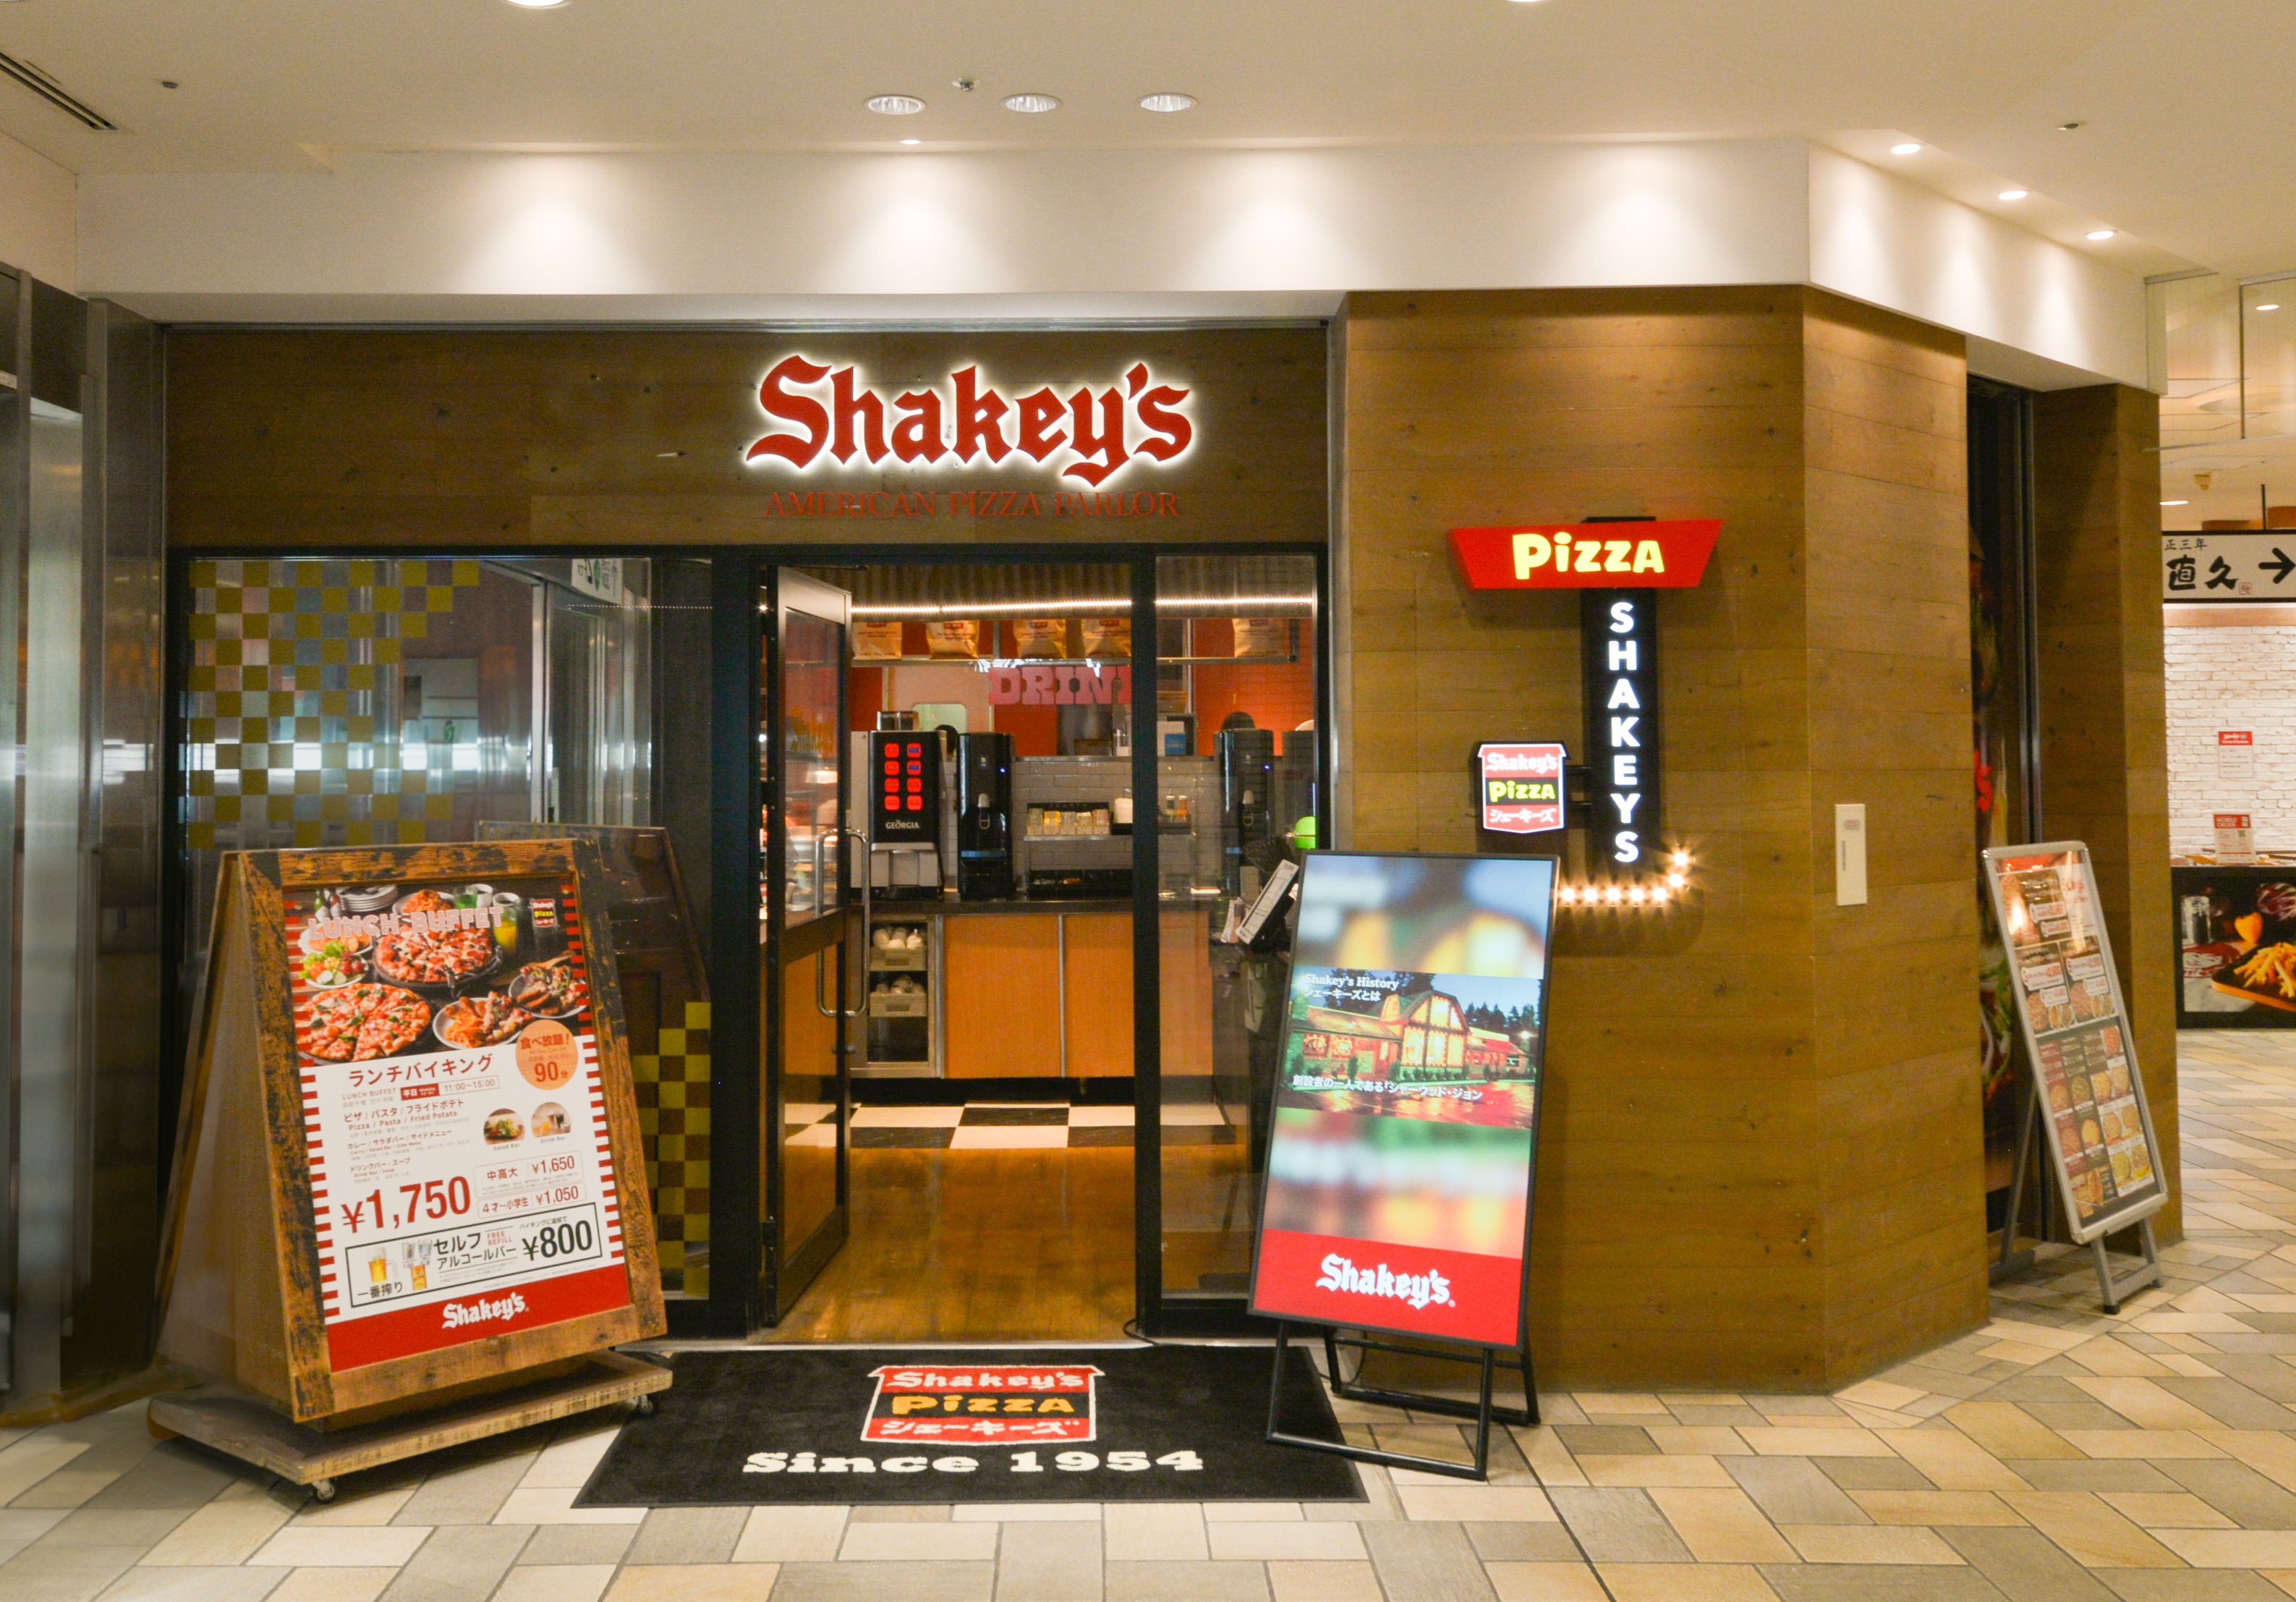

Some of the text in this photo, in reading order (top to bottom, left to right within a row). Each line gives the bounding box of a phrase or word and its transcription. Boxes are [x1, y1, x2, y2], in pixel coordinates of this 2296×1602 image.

[746, 355, 1193, 487] Shakey's
[764, 491, 1180, 518] AMERICAN PIZZA PARLOR
[2166, 554, 2240, 591] 直久
[1607, 602, 1641, 863] SHAKEYS
[1485, 753, 1558, 774] Shakey's
[1489, 808, 1557, 823] シェーキーズ
[307, 906, 504, 941] LUNCH BUFFET
[1304, 973, 1400, 991] Shakey's History
[1304, 988, 1382, 1001] シェーキーズとは
[349, 1053, 493, 1088] ランチバイキング
[342, 1088, 396, 1101] LUNCH BUFFET
[371, 1107, 398, 1119] パスタ
[406, 1098, 464, 1114] フライドポテト
[433, 1111, 458, 1119] Potato
[487, 1155, 576, 1181] 中高大 ¥1,650
[341, 1176, 471, 1234] ¥1,750
[536, 1185, 579, 1205] ¥1,050
[434, 1232, 482, 1255] セルフ
[522, 1219, 593, 1262] ¥800
[437, 1245, 517, 1270] アルコールバー
[357, 1281, 404, 1299] 一番搾り
[1315, 1253, 1451, 1310] Shakey's
[442, 1292, 526, 1328] Shakey's
[885, 1371, 1084, 1389] Shakey's
[880, 1420, 1081, 1436] シェーキーズ
[742, 1450, 1204, 1473] Since 1954
